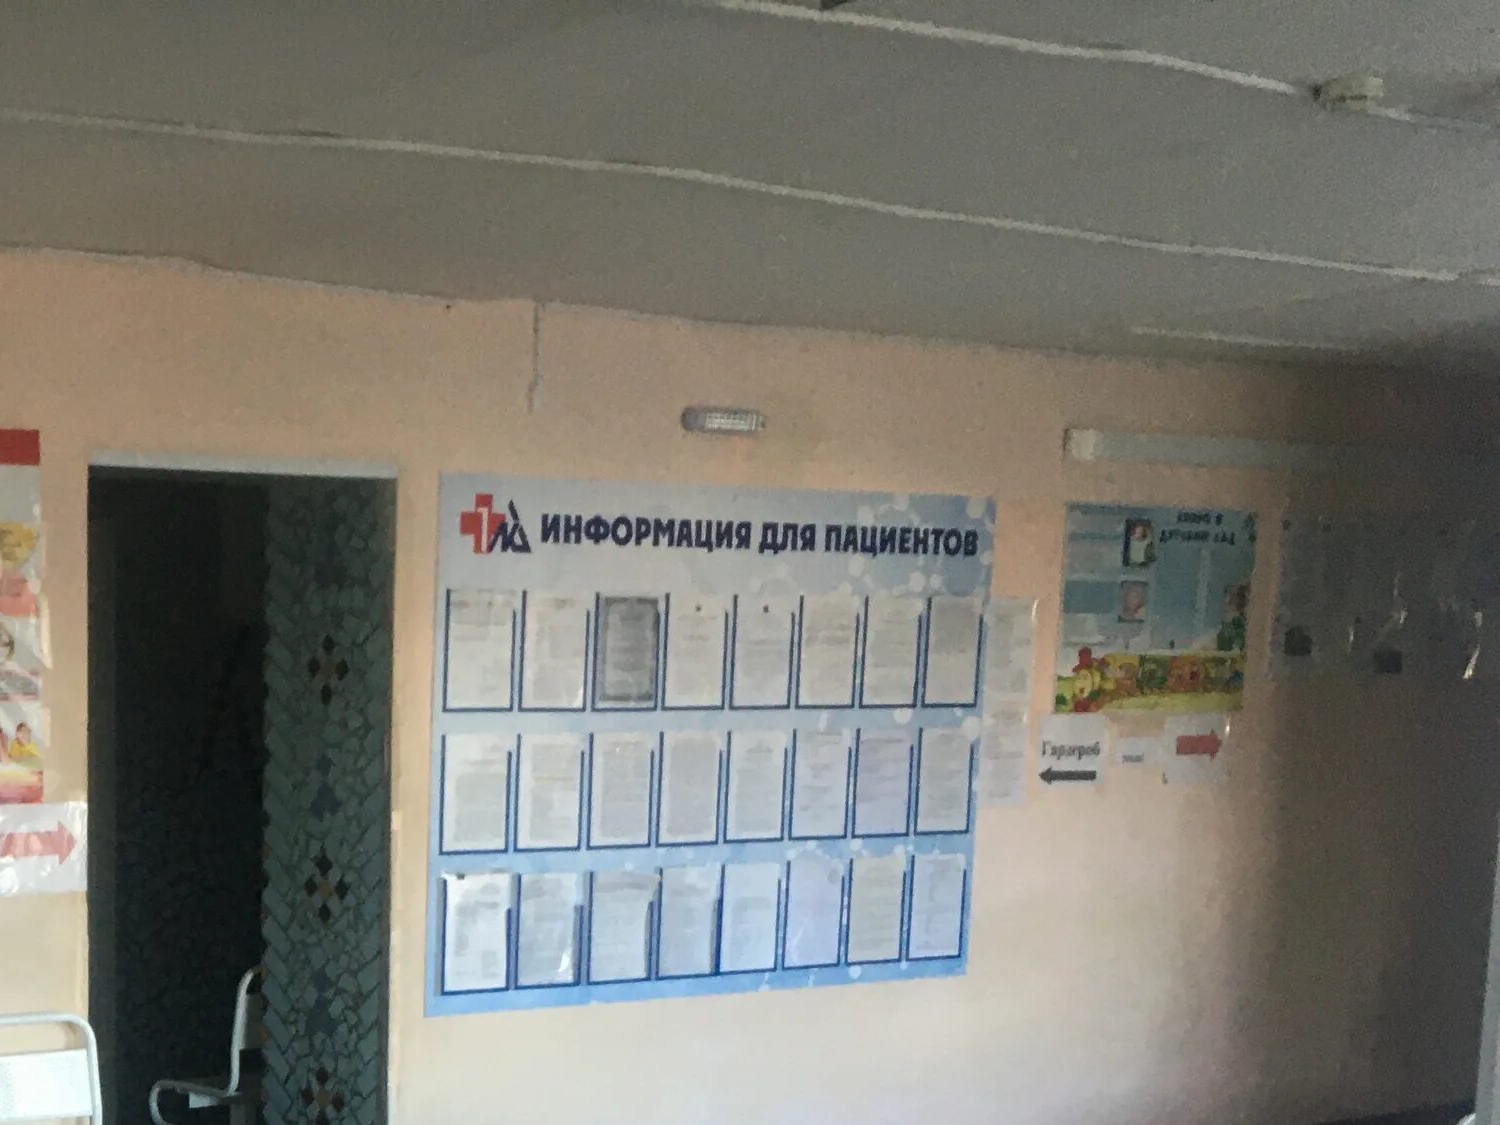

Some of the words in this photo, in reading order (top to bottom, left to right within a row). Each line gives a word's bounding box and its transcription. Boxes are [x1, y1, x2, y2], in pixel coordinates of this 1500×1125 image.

[541, 514, 751, 552] ИНФОРМАЦИЯ
[758, 522, 816, 554] ДЛЯ
[825, 524, 979, 559] ПАЦИЕНТОВ
